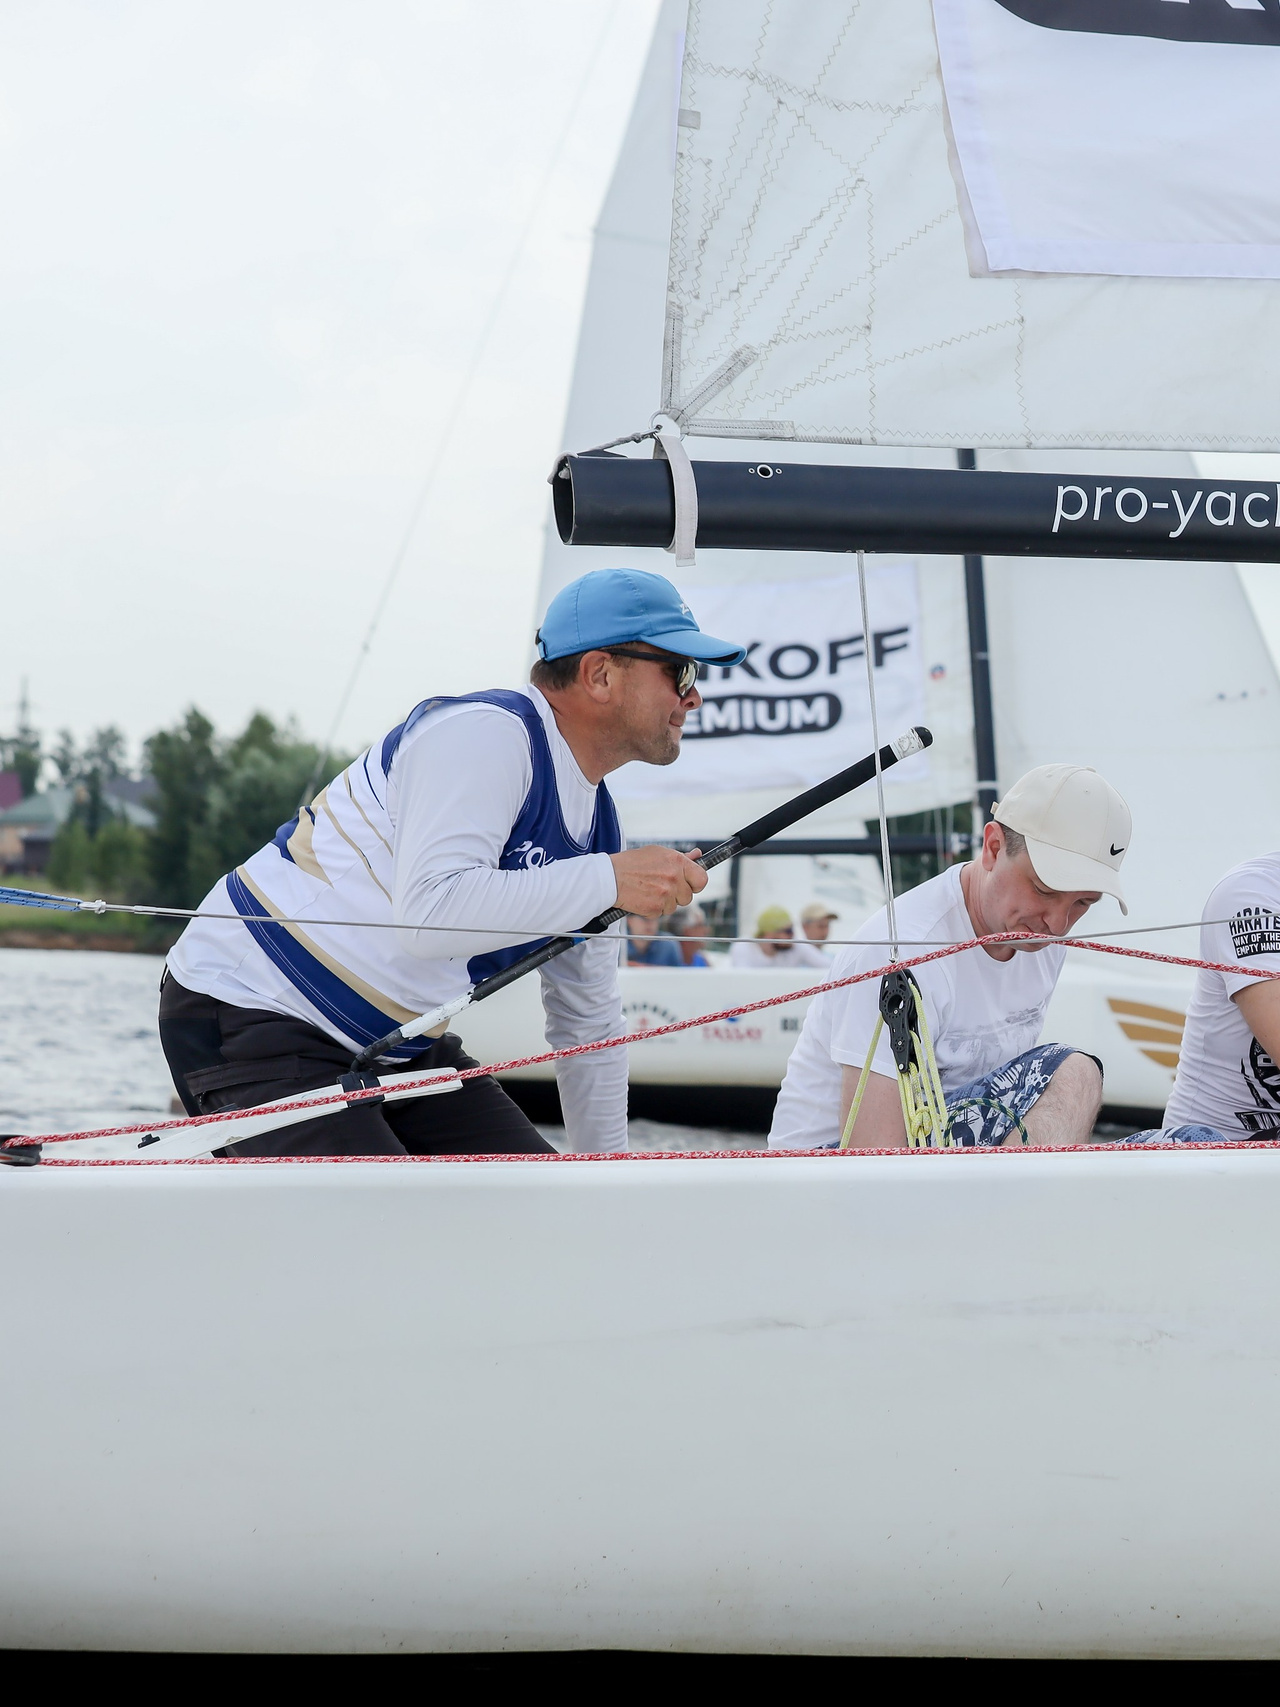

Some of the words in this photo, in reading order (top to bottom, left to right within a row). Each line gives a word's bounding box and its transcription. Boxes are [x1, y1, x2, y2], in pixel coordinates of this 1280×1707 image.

[1233, 934, 1249, 947] WAY
[1250, 932, 1262, 943] OF
[1263, 932, 1280, 942] THE
[1236, 942, 1259, 956] EMPTY
[1260, 942, 1280, 951] HAND
